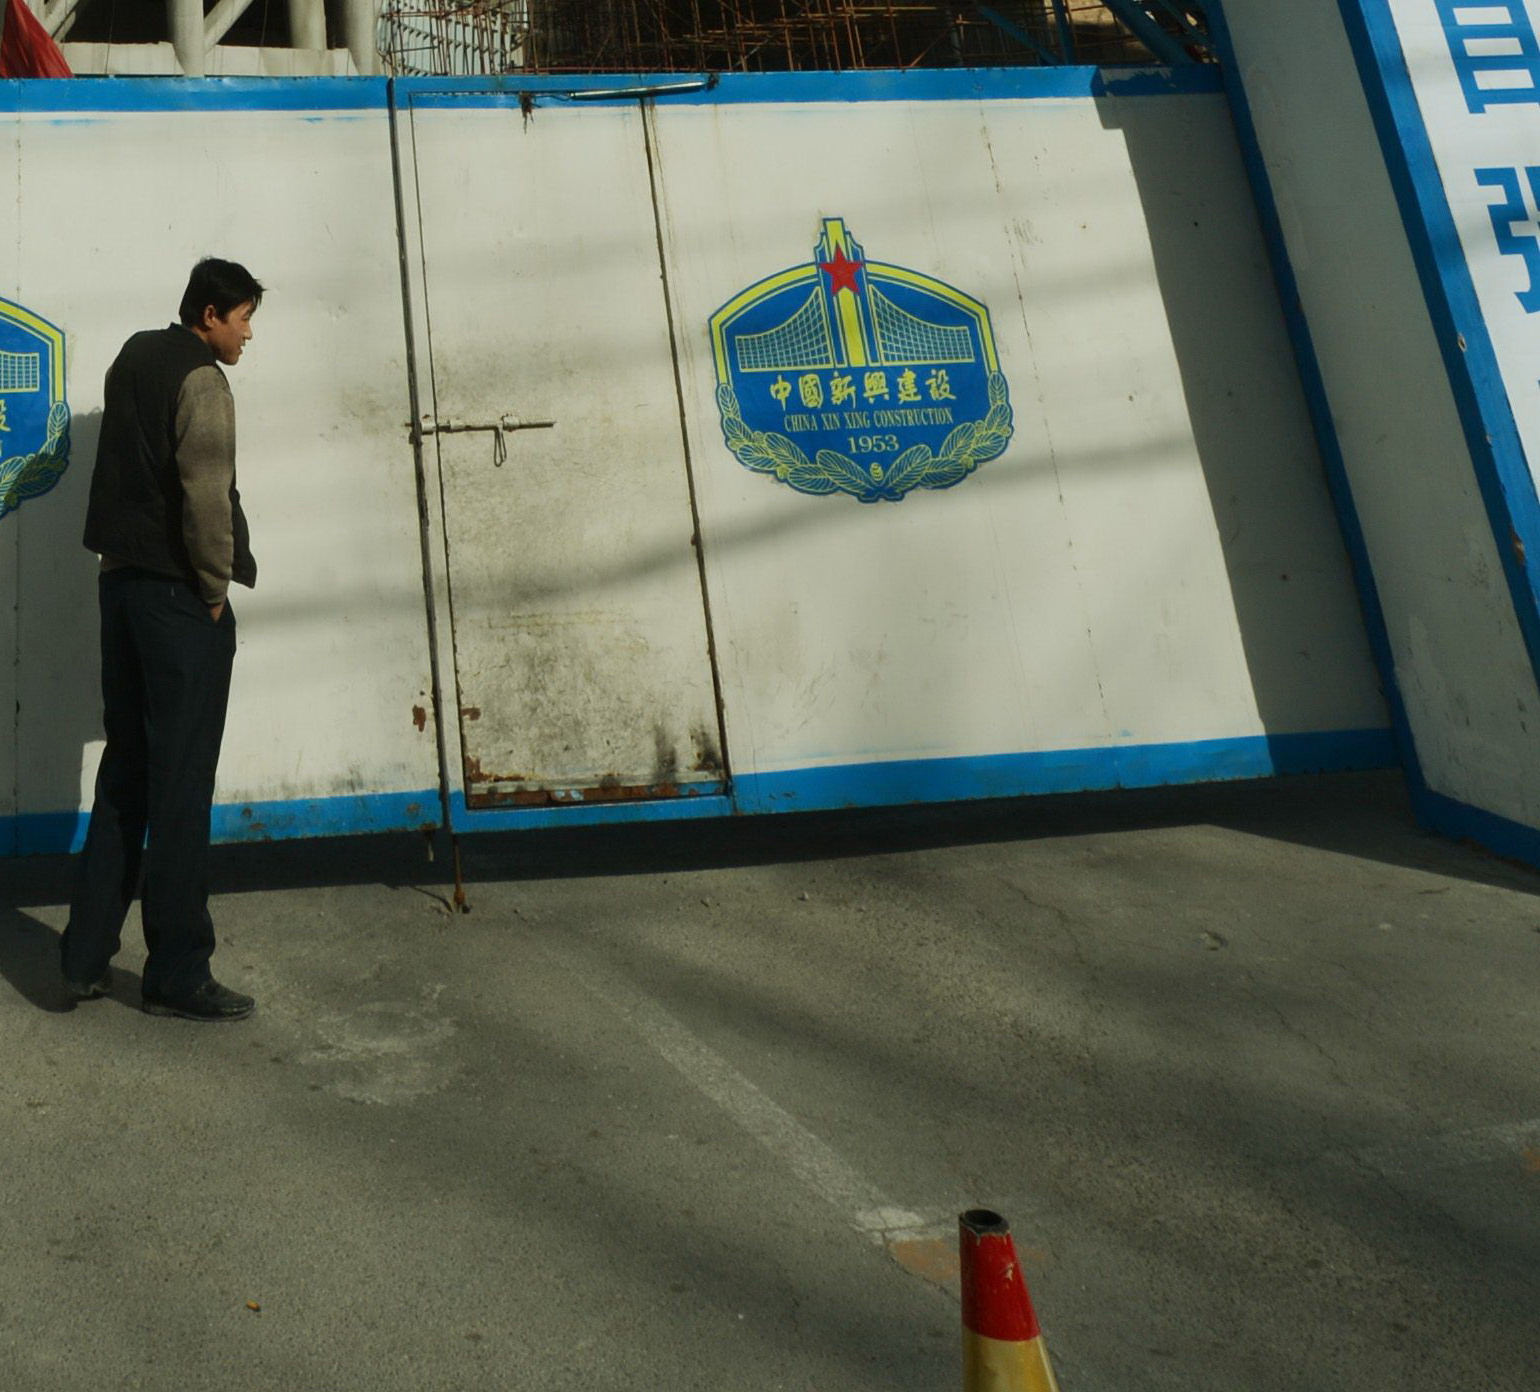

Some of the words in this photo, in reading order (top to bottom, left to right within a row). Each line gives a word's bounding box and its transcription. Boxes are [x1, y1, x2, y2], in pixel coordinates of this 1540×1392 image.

[784, 414, 818, 432] CHINA
[822, 412, 841, 429] XIN
[845, 411, 870, 428] XING
[875, 407, 953, 427] CONSTRUCTION
[847, 434, 900, 453] 1953
